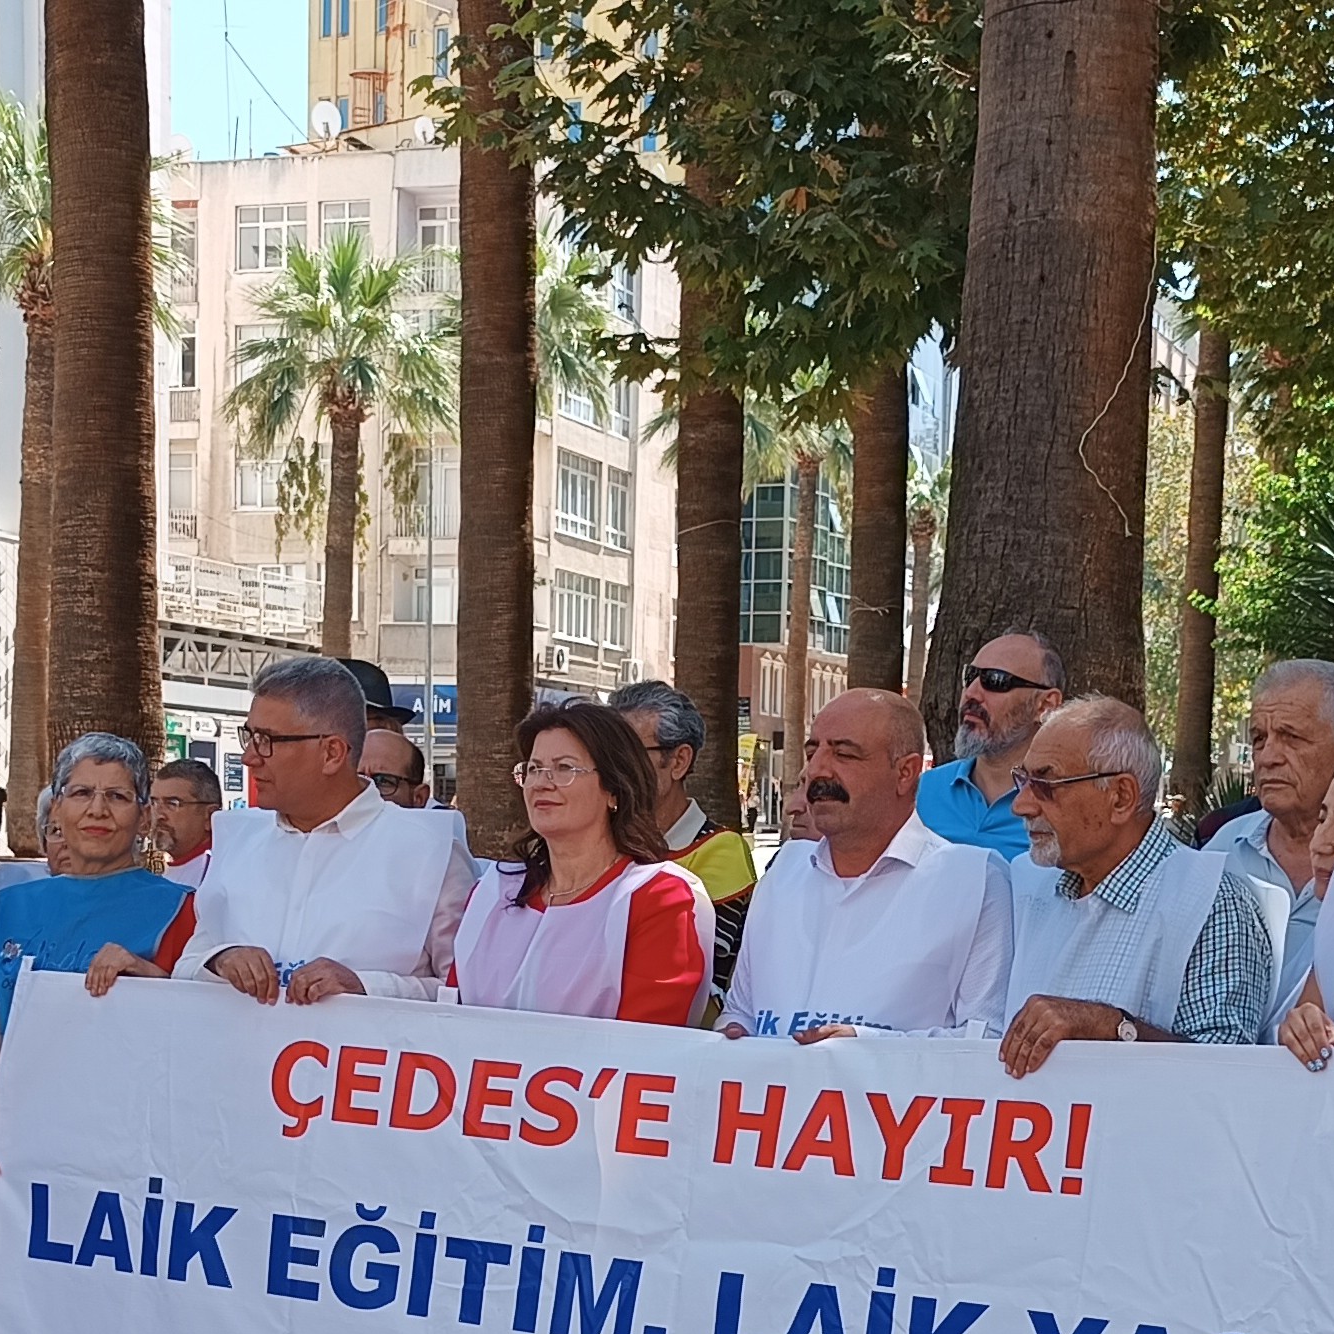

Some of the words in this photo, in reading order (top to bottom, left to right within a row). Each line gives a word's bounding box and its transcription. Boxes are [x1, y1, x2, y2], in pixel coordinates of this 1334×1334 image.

[412, 694, 451, 713] AİM
[712, 1079, 1094, 1195] HAYIR!
[28, 1177, 238, 1288] LAİK
